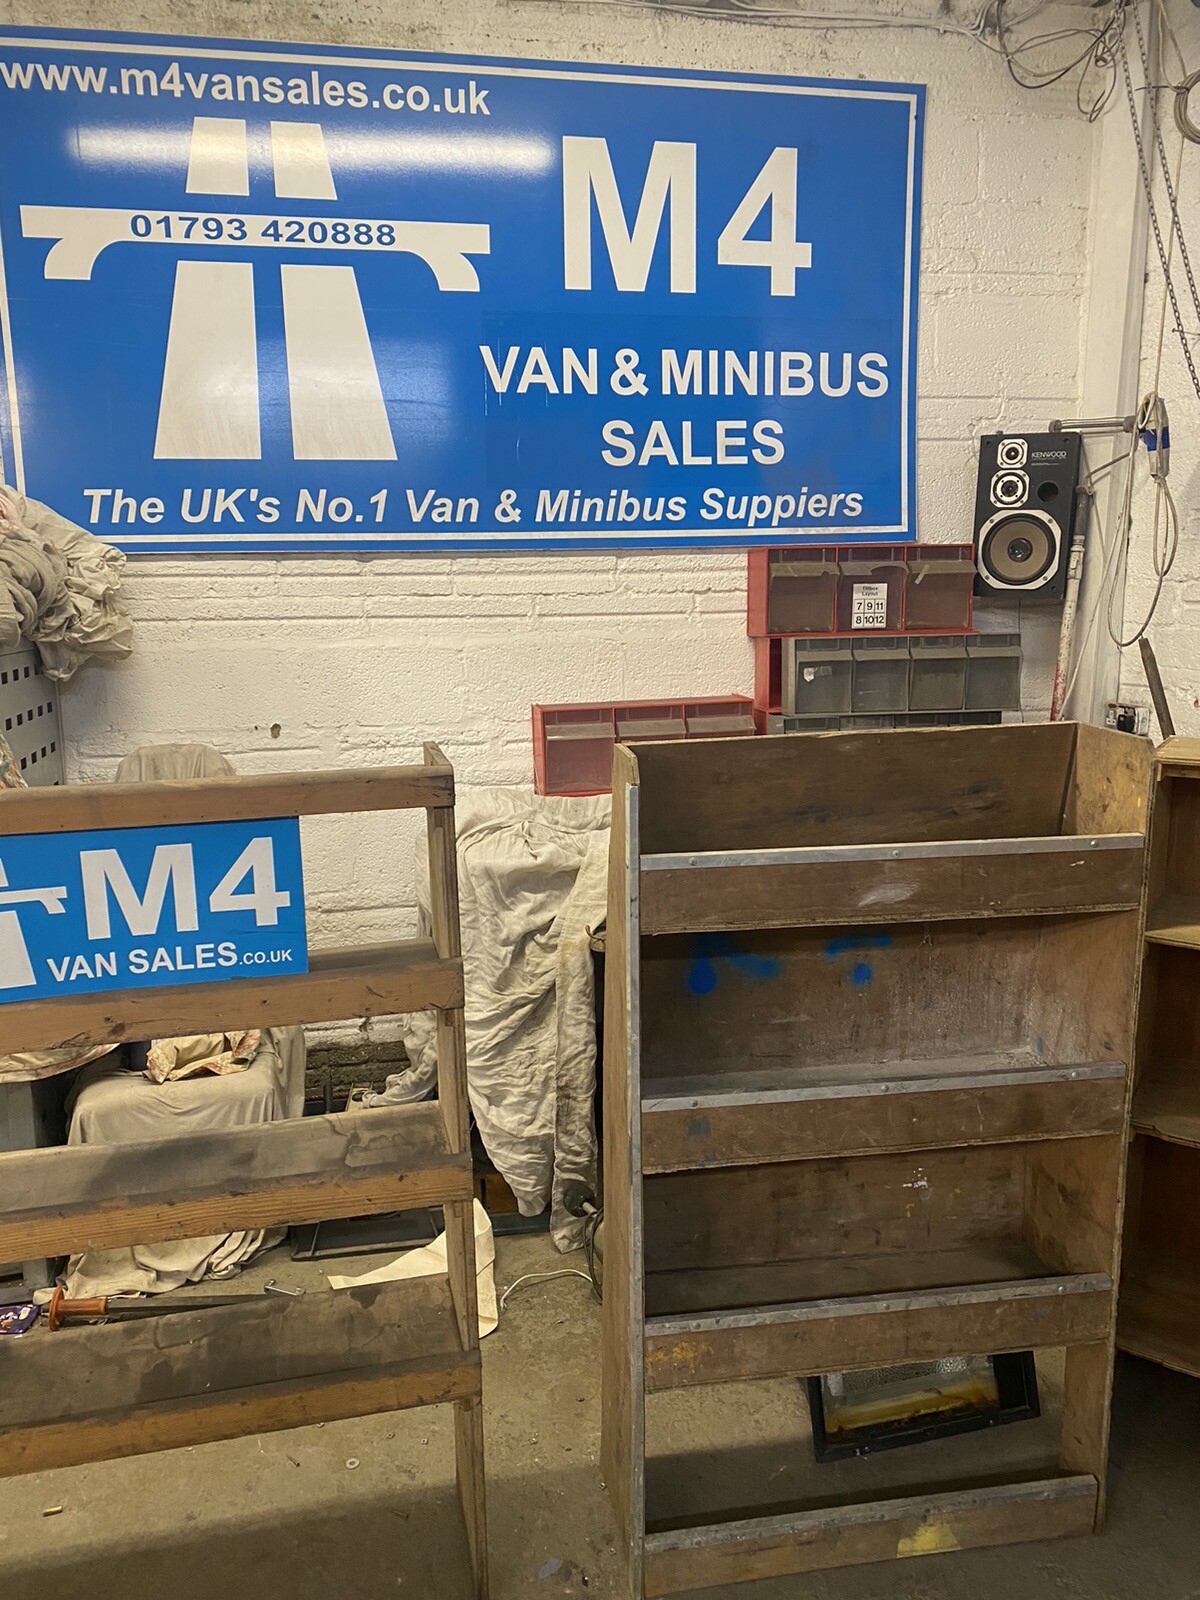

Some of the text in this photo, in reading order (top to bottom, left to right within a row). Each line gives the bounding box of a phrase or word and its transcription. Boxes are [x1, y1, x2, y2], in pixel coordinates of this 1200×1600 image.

[0, 61, 491, 115] www.m4vansales.co.uk
[130, 214, 396, 246] 01793 420888
[562, 135, 813, 297] M4
[479, 345, 889, 398] VAN & MINIBUS
[600, 419, 785, 467] SALES
[1031, 450, 1067, 458] KENWOOD
[83, 486, 864, 527] The UK's No.1 Van & Minibus Suppiers
[855, 615, 884, 624] 8 10 12
[856, 602, 884, 611] 7 9 11
[79, 836, 291, 941] M4
[46, 951, 118, 982] VAN
